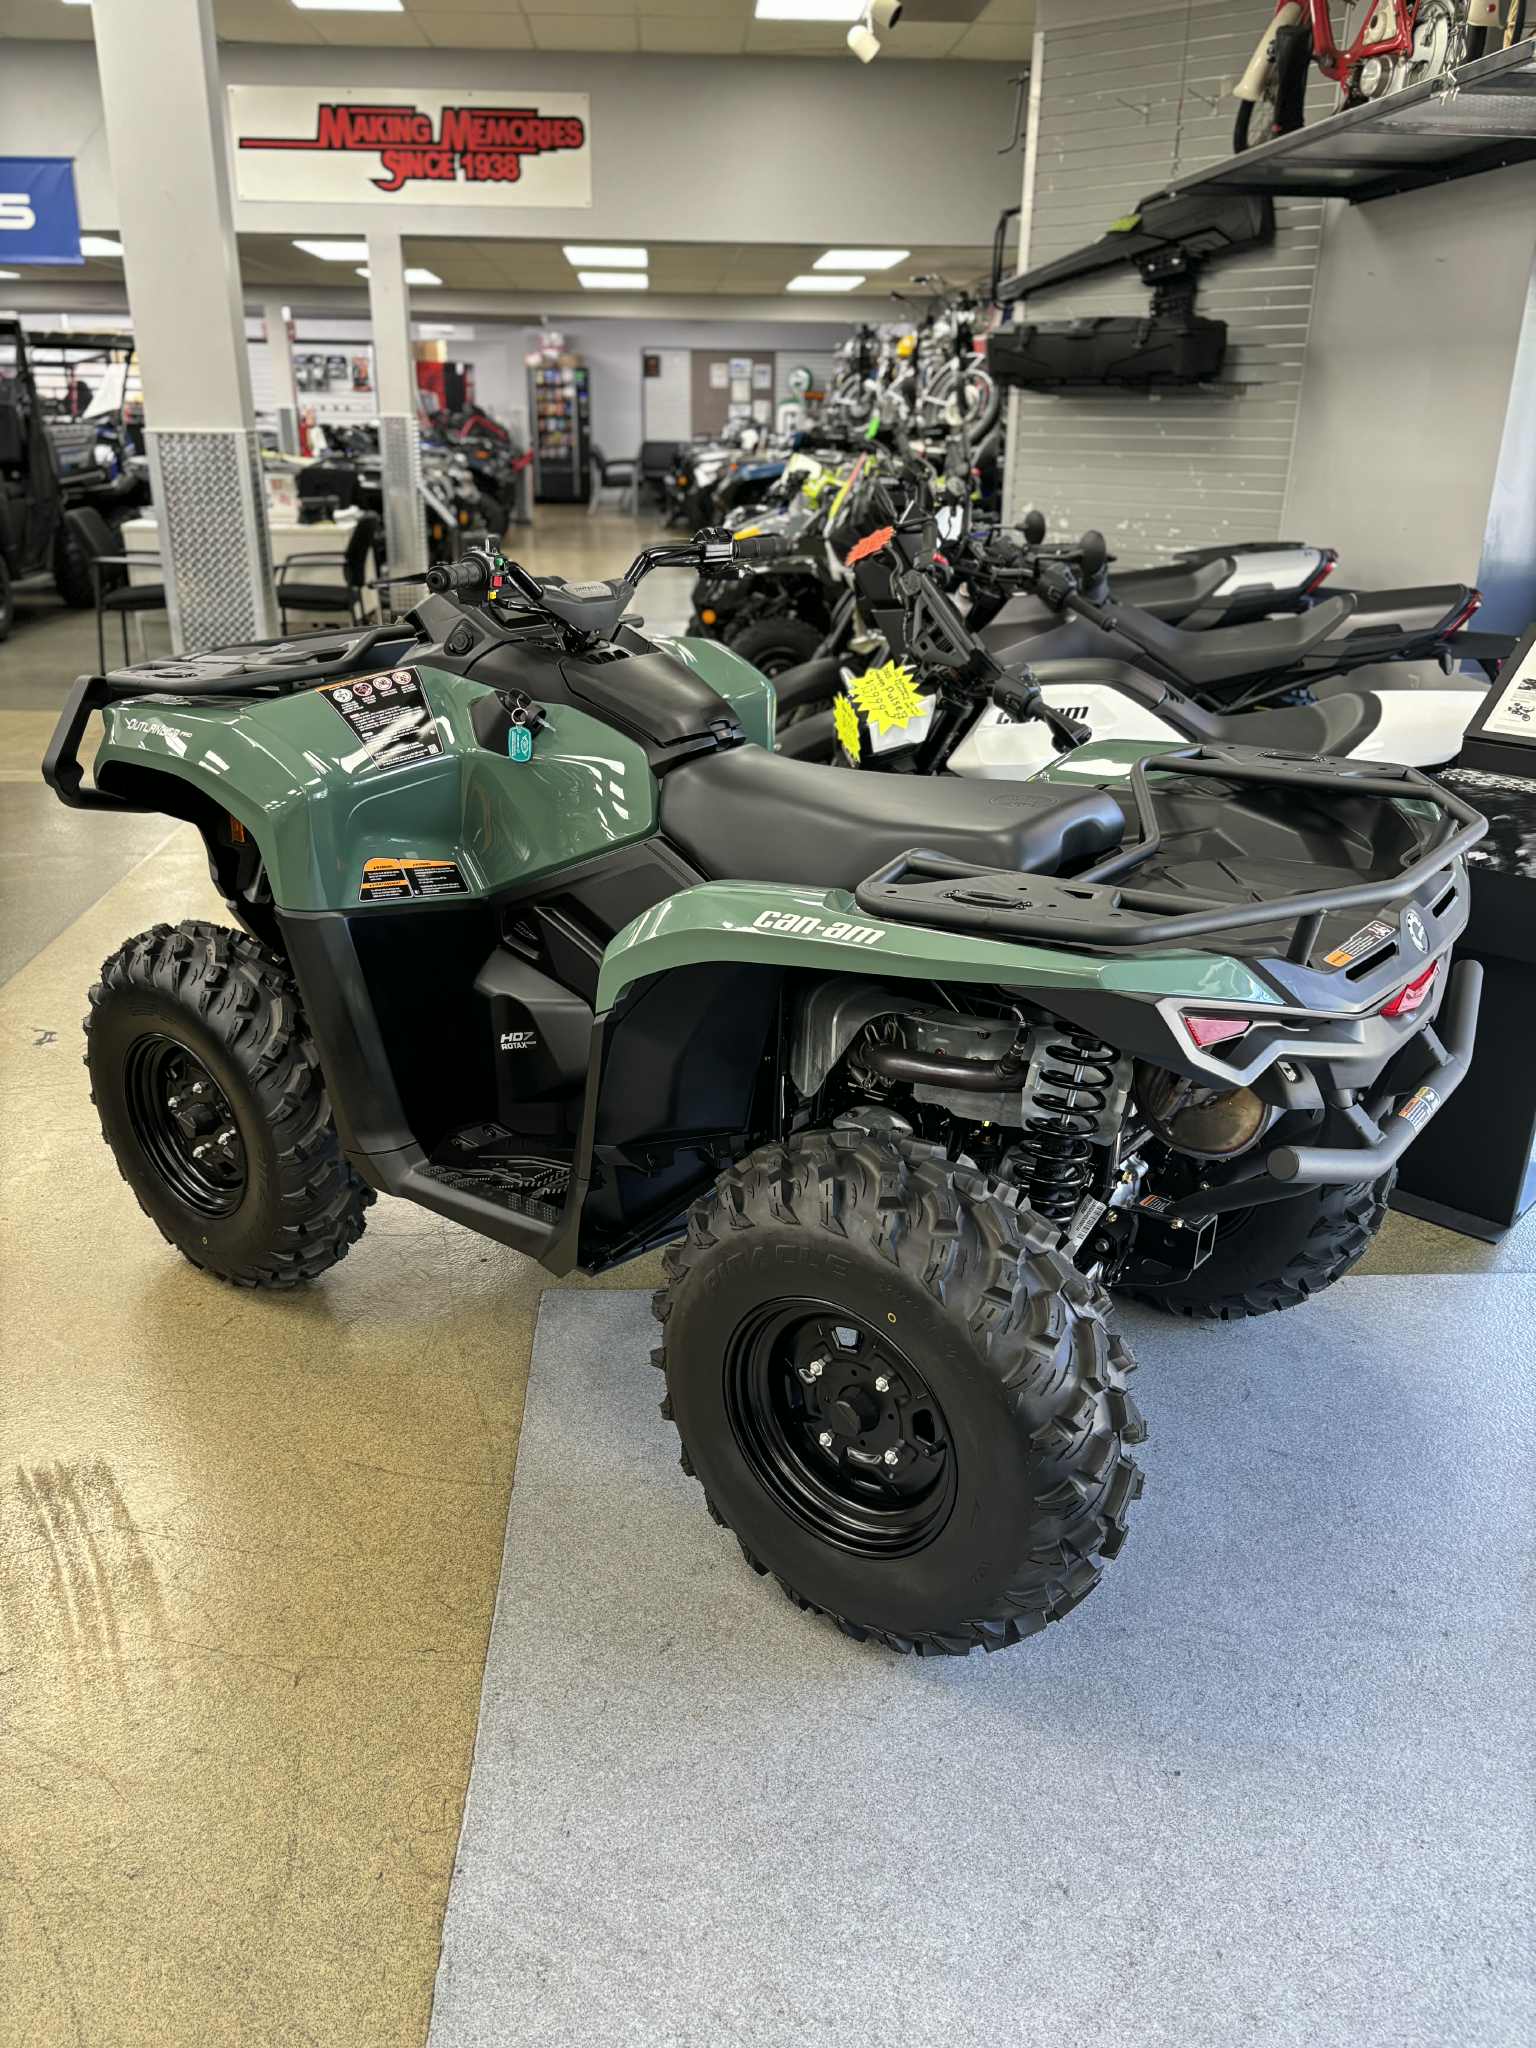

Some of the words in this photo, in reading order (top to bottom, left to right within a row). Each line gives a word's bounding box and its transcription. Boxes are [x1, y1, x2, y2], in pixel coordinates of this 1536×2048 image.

[318, 104, 432, 149] MAKING
[440, 107, 584, 152] MEMORIES
[370, 151, 456, 192] SINCE
[459, 152, 521, 182] 1938
[752, 910, 886, 945] can-am
[500, 1041, 528, 1050] ROTAX
